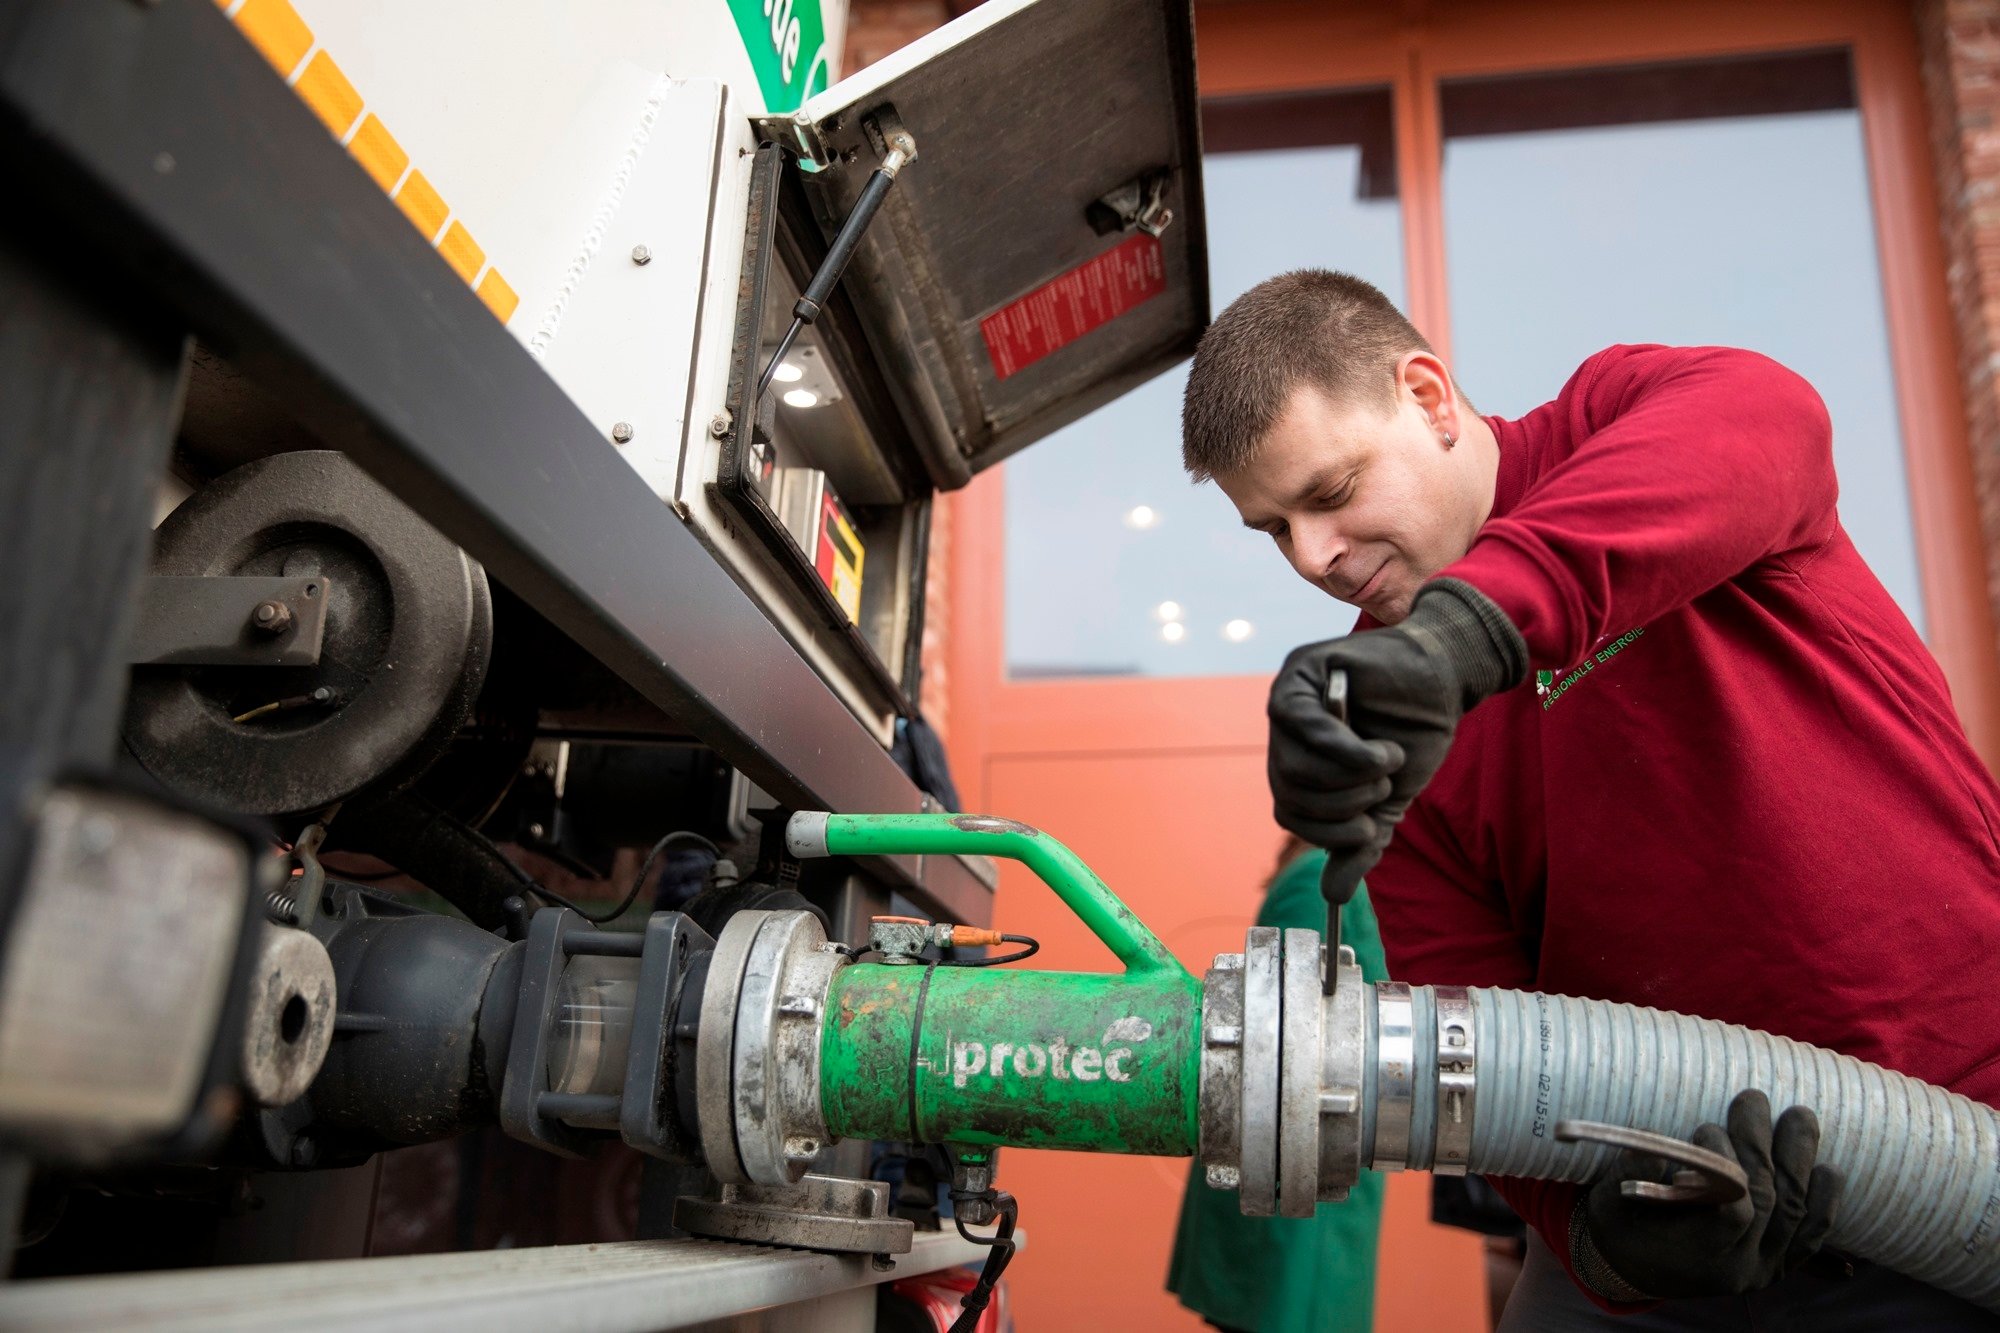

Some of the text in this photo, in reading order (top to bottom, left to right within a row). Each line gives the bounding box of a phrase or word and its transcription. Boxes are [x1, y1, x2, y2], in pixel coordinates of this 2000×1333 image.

[1542, 626, 1645, 711] REGIONALE ENERGIE
[953, 1035, 1132, 1089] protec
[1531, 1073, 1551, 1138] 02:15:53
